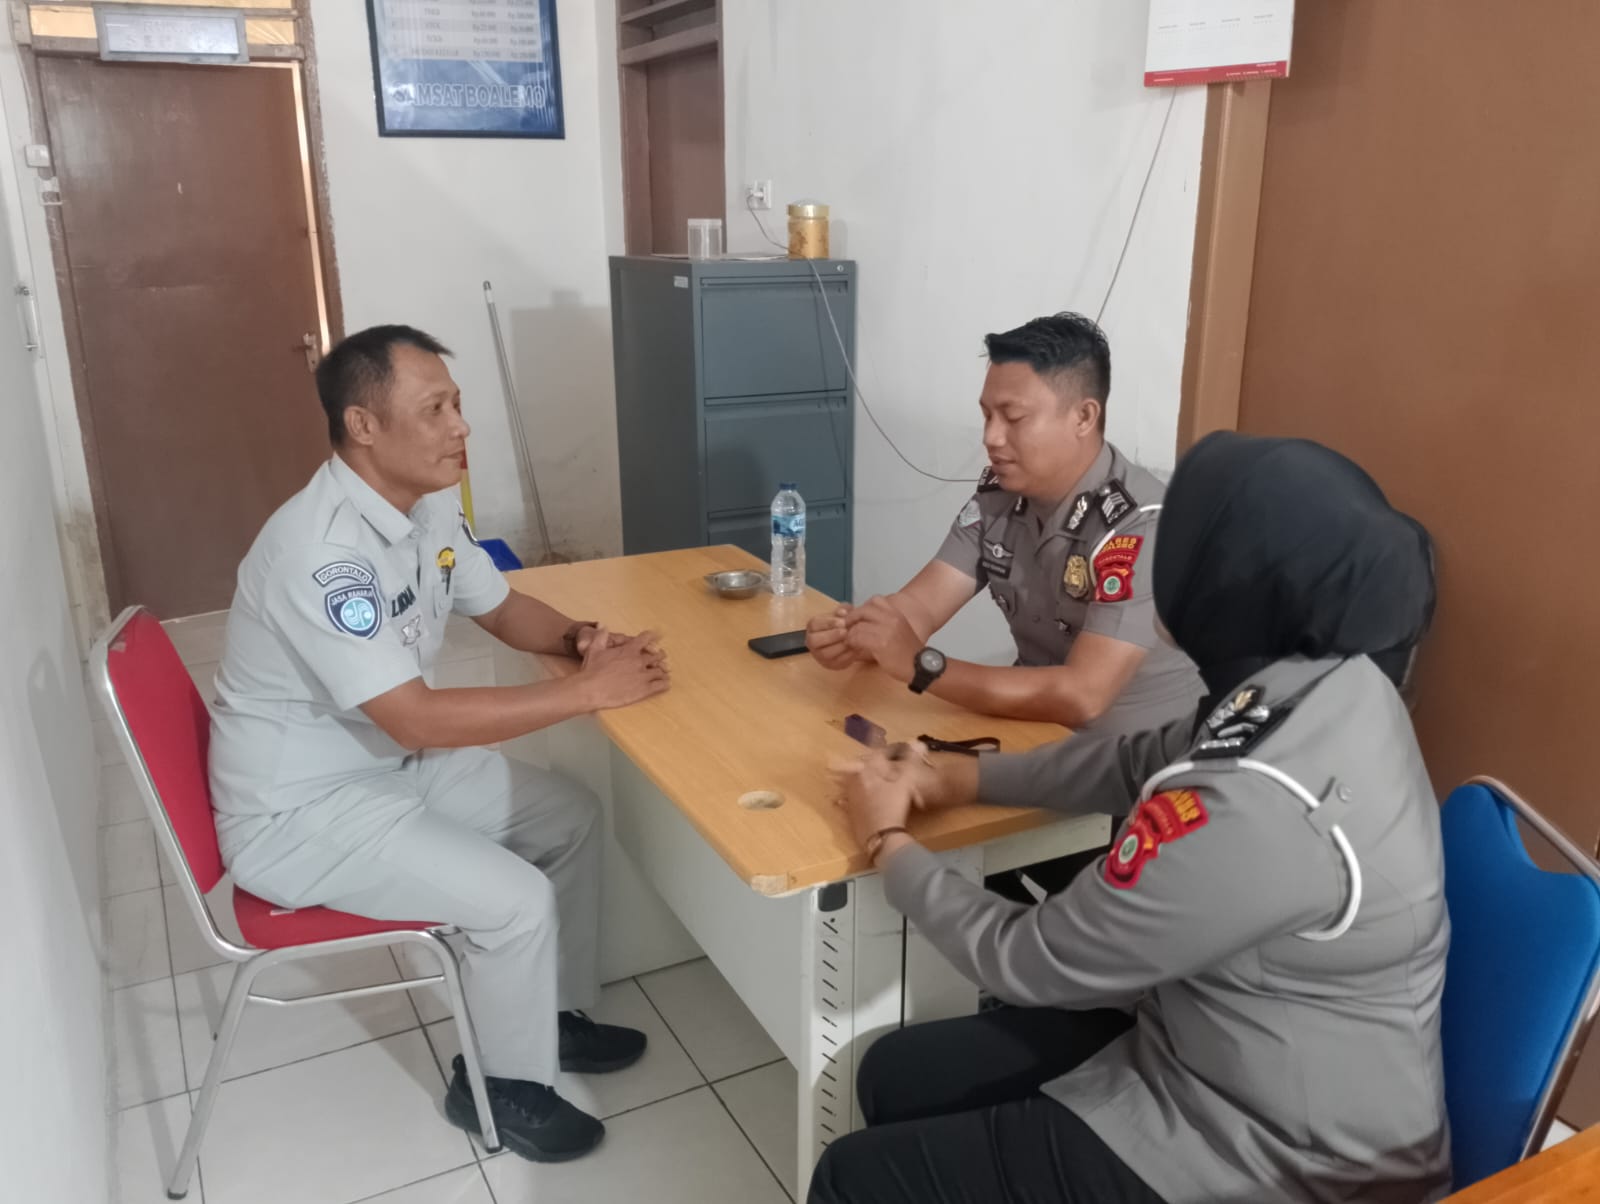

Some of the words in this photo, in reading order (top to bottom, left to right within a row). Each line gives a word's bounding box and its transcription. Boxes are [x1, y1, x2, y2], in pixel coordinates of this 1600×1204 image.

[391, 81, 463, 107] SAMSAT
[464, 83, 546, 108] BOALEMO
[320, 565, 368, 582] GORONTALO
[331, 593, 347, 606] JASA
